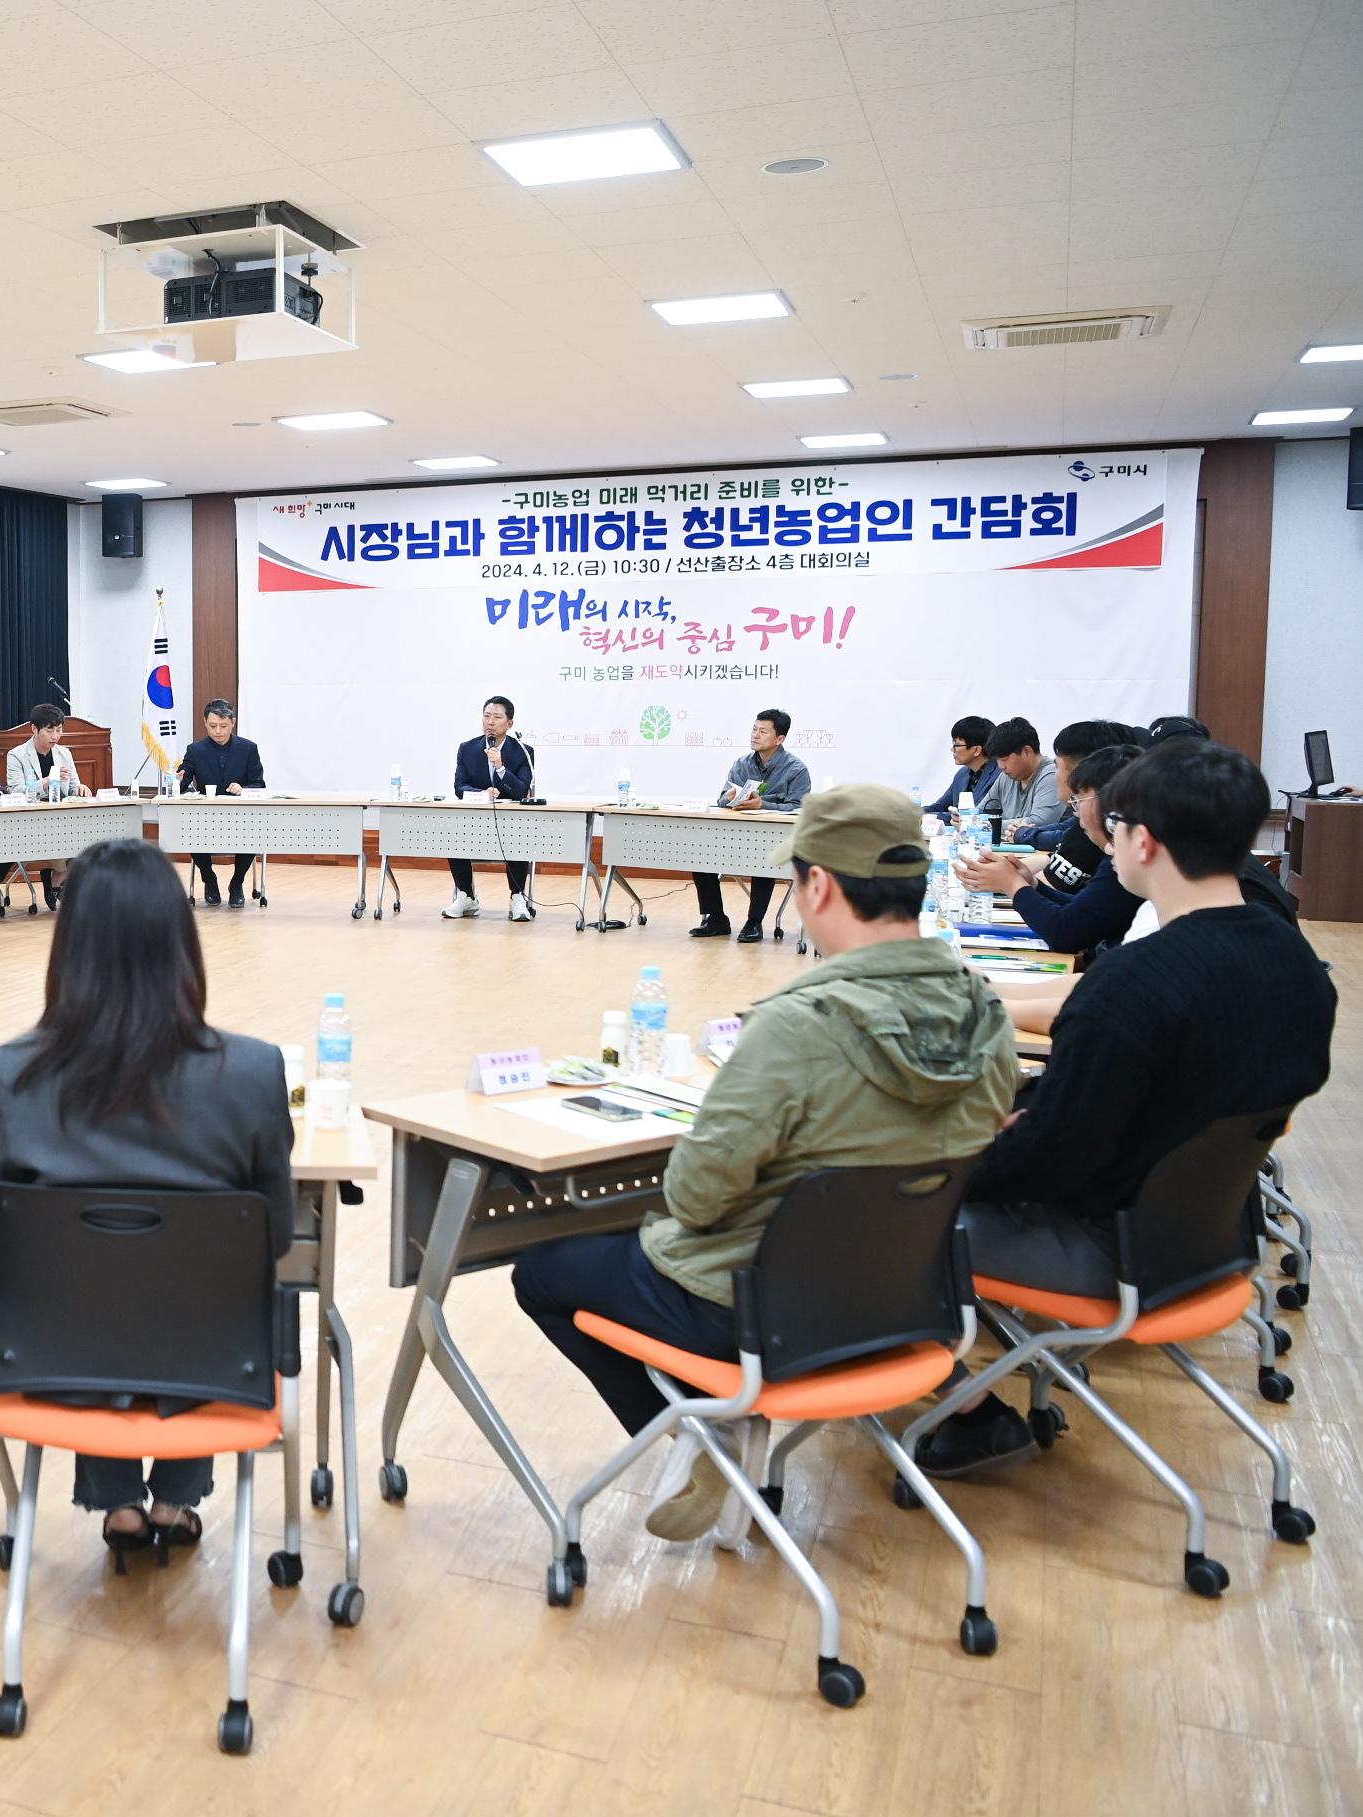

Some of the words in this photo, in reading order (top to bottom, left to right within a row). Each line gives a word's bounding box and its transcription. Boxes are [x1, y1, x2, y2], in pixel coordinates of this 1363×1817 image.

[1098, 464, 1148, 478] 구미시
[599, 486, 638, 506] 미래
[646, 482, 709, 503] 먹거리
[717, 478, 781, 500] 준비를
[320, 517, 486, 563] 시장님과
[497, 507, 669, 557] 함께하는
[681, 498, 914, 550] 청년농업인
[930, 491, 1079, 541] 간담회
[612, 557, 660, 574] 10:30
[676, 554, 762, 573] 선산출장소
[765, 553, 795, 570] 4층
[799, 550, 870, 570] 대회의실
[485, 588, 608, 632] 미래의
[617, 595, 677, 625] 시작,
[578, 625, 666, 656] 혁신의
[676, 621, 737, 655] 중심
[743, 605, 857, 650] 구미!
[558, 665, 587, 682] 구미
[592, 664, 635, 682] 농업을
[639, 663, 779, 681] 재도약시키겠습니다!
